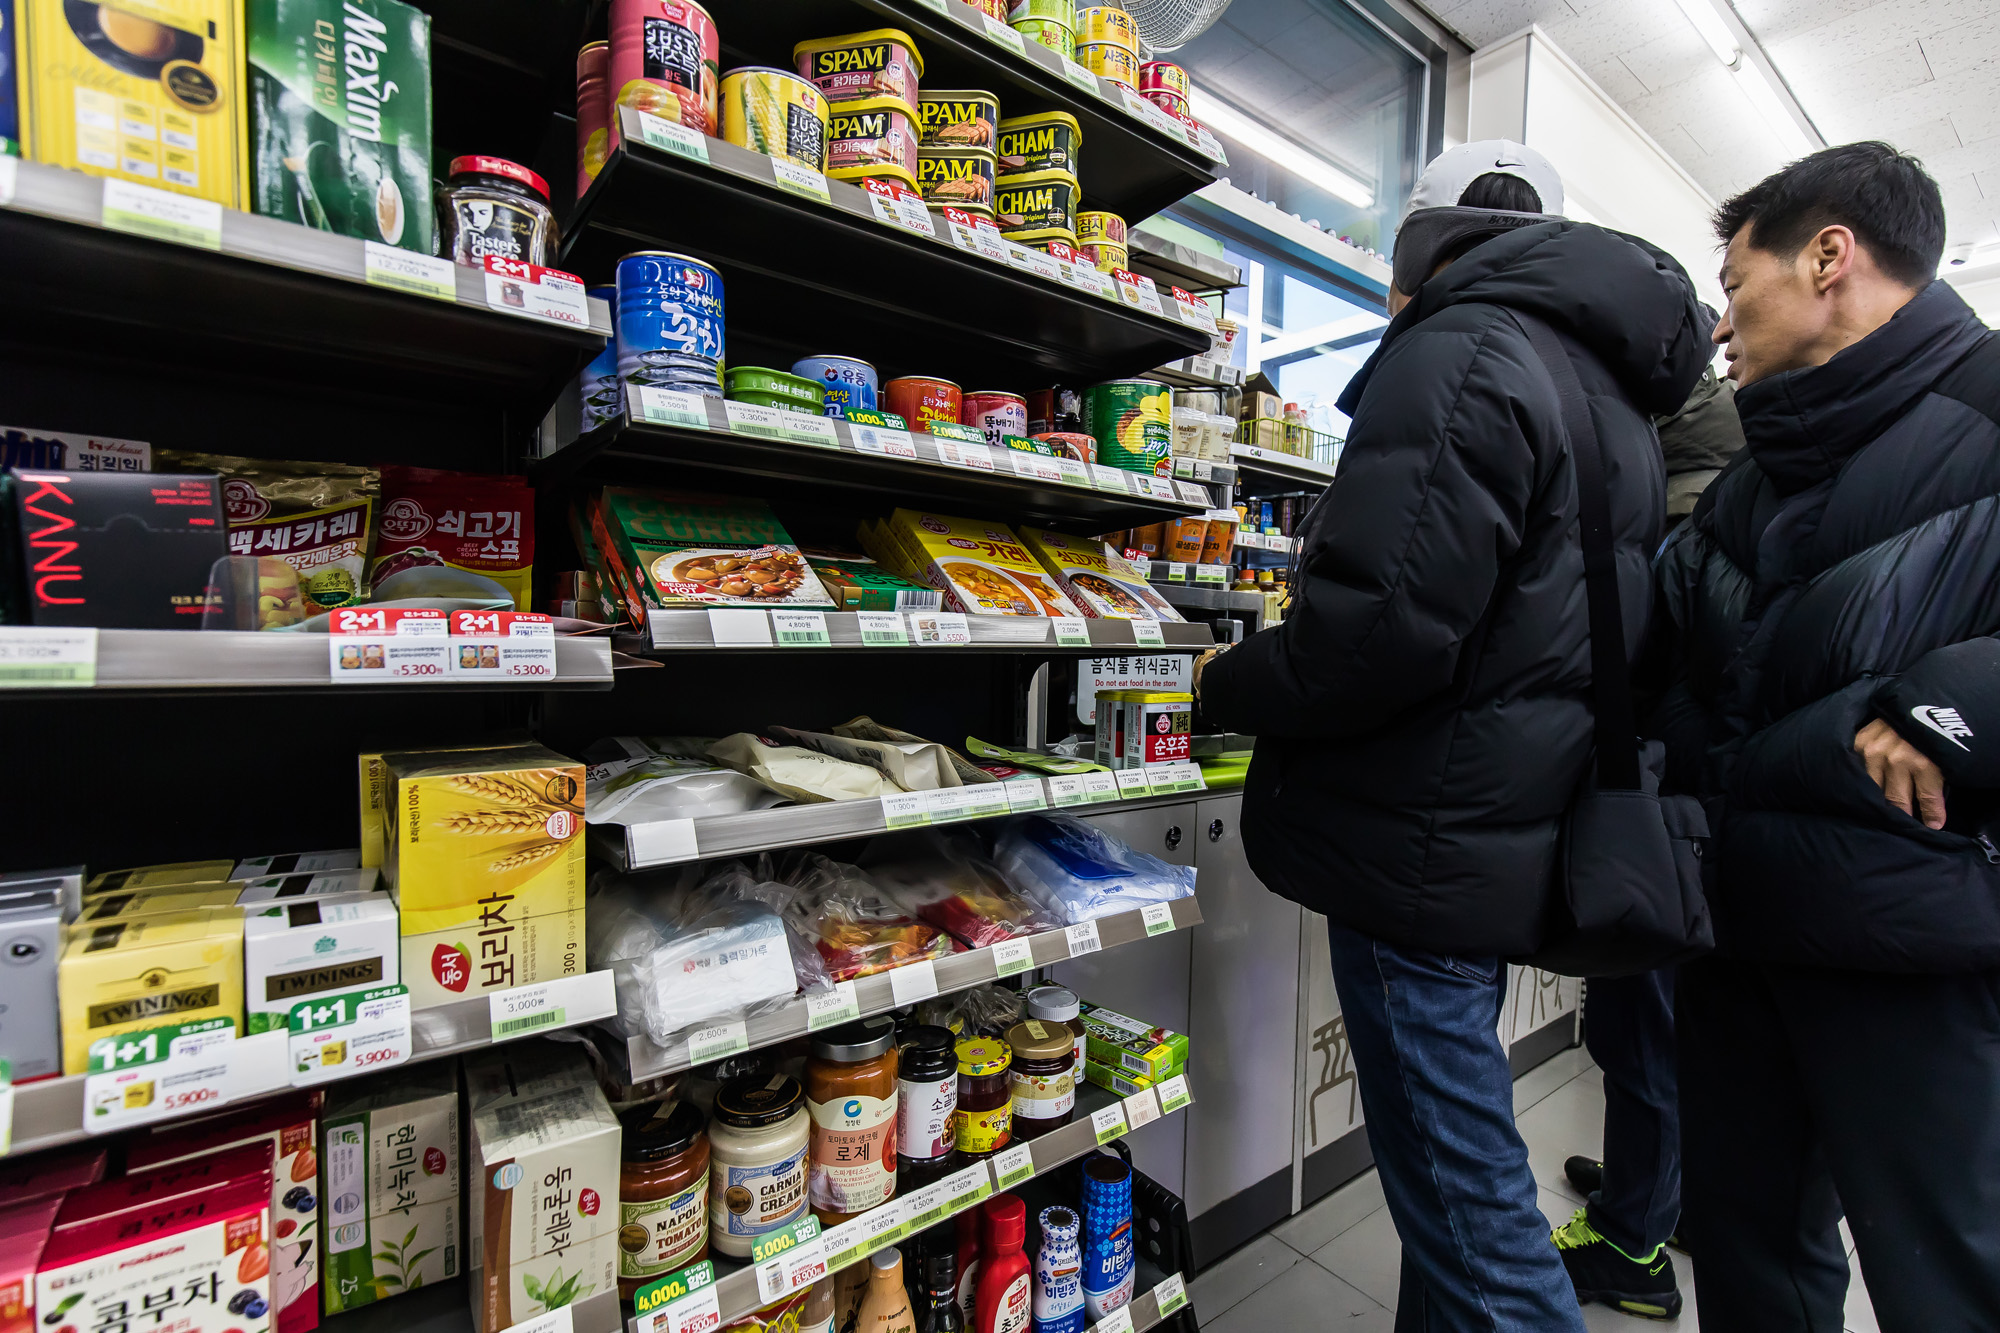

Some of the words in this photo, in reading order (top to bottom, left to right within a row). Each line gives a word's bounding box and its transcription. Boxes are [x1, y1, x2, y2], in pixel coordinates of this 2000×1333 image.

[312, 19, 337, 107] 디카페인
[819, 46, 884, 74] SPAM
[343, 1, 399, 142] Maxim
[833, 73, 871, 88] 닭가슴살
[792, 114, 821, 140] JUST
[1024, 153, 1048, 163] Original
[918, 159, 975, 182] PAM
[867, 179, 894, 196] 2+1
[946, 208, 971, 225] 2+1
[1022, 212, 1046, 222] Original
[469, 231, 522, 254] Taster's
[1053, 243, 1071, 259] 2+1
[471, 245, 519, 261] Choice
[491, 256, 530, 277] 2+1
[1116, 269, 1134, 284] 2+1
[657, 281, 686, 300] 동원
[1174, 288, 1191, 302] 2+1
[660, 300, 722, 357] 꽁치
[842, 368, 866, 387] 유동
[660, 400, 689, 411] 5,500원
[824, 390, 850, 403] 연산
[739, 412, 768, 423] 3,300원
[847, 411, 885, 427] 1,000원
[984, 415, 1015, 429] 뚝배기
[1014, 406, 1025, 420] 유동
[884, 418, 906, 430] 할인
[965, 431, 983, 443] 할인
[227, 499, 257, 516] 뚜기
[383, 518, 422, 534] 오뚜기
[436, 510, 521, 539] 쇠고기
[630, 518, 777, 543] CURRY
[20, 473, 86, 606] KANU
[286, 540, 358, 570] 약간매운맛
[480, 539, 521, 561] 스프
[979, 541, 1033, 564] 카레
[1125, 549, 1137, 558] 2+1
[668, 586, 697, 594] HOT
[339, 610, 386, 630] 2+1
[459, 612, 500, 631] 2+1
[788, 621, 812, 629] 4,800원
[401, 663, 443, 676] 5,300원
[513, 663, 551, 676] 5,300원
[1091, 657, 1130, 675] 음식물
[1134, 657, 1182, 676] 취식금지
[1095, 679, 1104, 687] Do
[1130, 679, 1144, 687] food
[1145, 679, 1151, 687] in
[1152, 679, 1162, 687] the
[1928, 707, 1974, 737] NIKE
[1154, 735, 1189, 756] 순후추
[893, 803, 916, 811] 1,900원
[477, 891, 515, 988] 보리차
[441, 950, 463, 986] 동서
[563, 953, 576, 975] 300
[278, 963, 373, 993] TWININGS
[97, 989, 213, 1026] TWININGS
[508, 998, 545, 1013] 3,000원
[816, 997, 842, 1009] 2,800원
[296, 999, 347, 1031] 1+1
[698, 1028, 728, 1042] 2,600원
[98, 1033, 158, 1070] 1+1
[355, 1048, 400, 1068] 5,900원
[765, 1115, 782, 1124] OPEN
[827, 1135, 857, 1145] 토마토와
[858, 1130, 878, 1144] 생크림
[835, 1142, 871, 1161] 로제
[387, 1123, 418, 1216] 현미녹차
[833, 1167, 871, 1177] 스파게티소스
[1003, 1158, 1023, 1171] 6,000원
[760, 1170, 802, 1197] CARNIA
[951, 1180, 972, 1194] 4,500원
[582, 1191, 596, 1213] 동서
[760, 1185, 802, 1213] CREAM
[912, 1198, 935, 1212] 4,500원
[543, 1166, 573, 1259] 둥굴레차
[656, 1199, 702, 1233] NAPOLI
[656, 1217, 702, 1250] TOMATO
[795, 1223, 817, 1244] 할인
[871, 1219, 895, 1233] 8,900원
[754, 1235, 796, 1262] 3,000원
[824, 1237, 850, 1254] 8,200원
[1114, 1234, 1128, 1252] 팔도
[1101, 1242, 1133, 1275] 비빔장
[341, 1276, 358, 1296] 25
[686, 1269, 712, 1291] 할인
[638, 1281, 686, 1311] 4,000원
[1045, 1281, 1078, 1300] 비빔장
[91, 1271, 225, 1333] 콤부차
